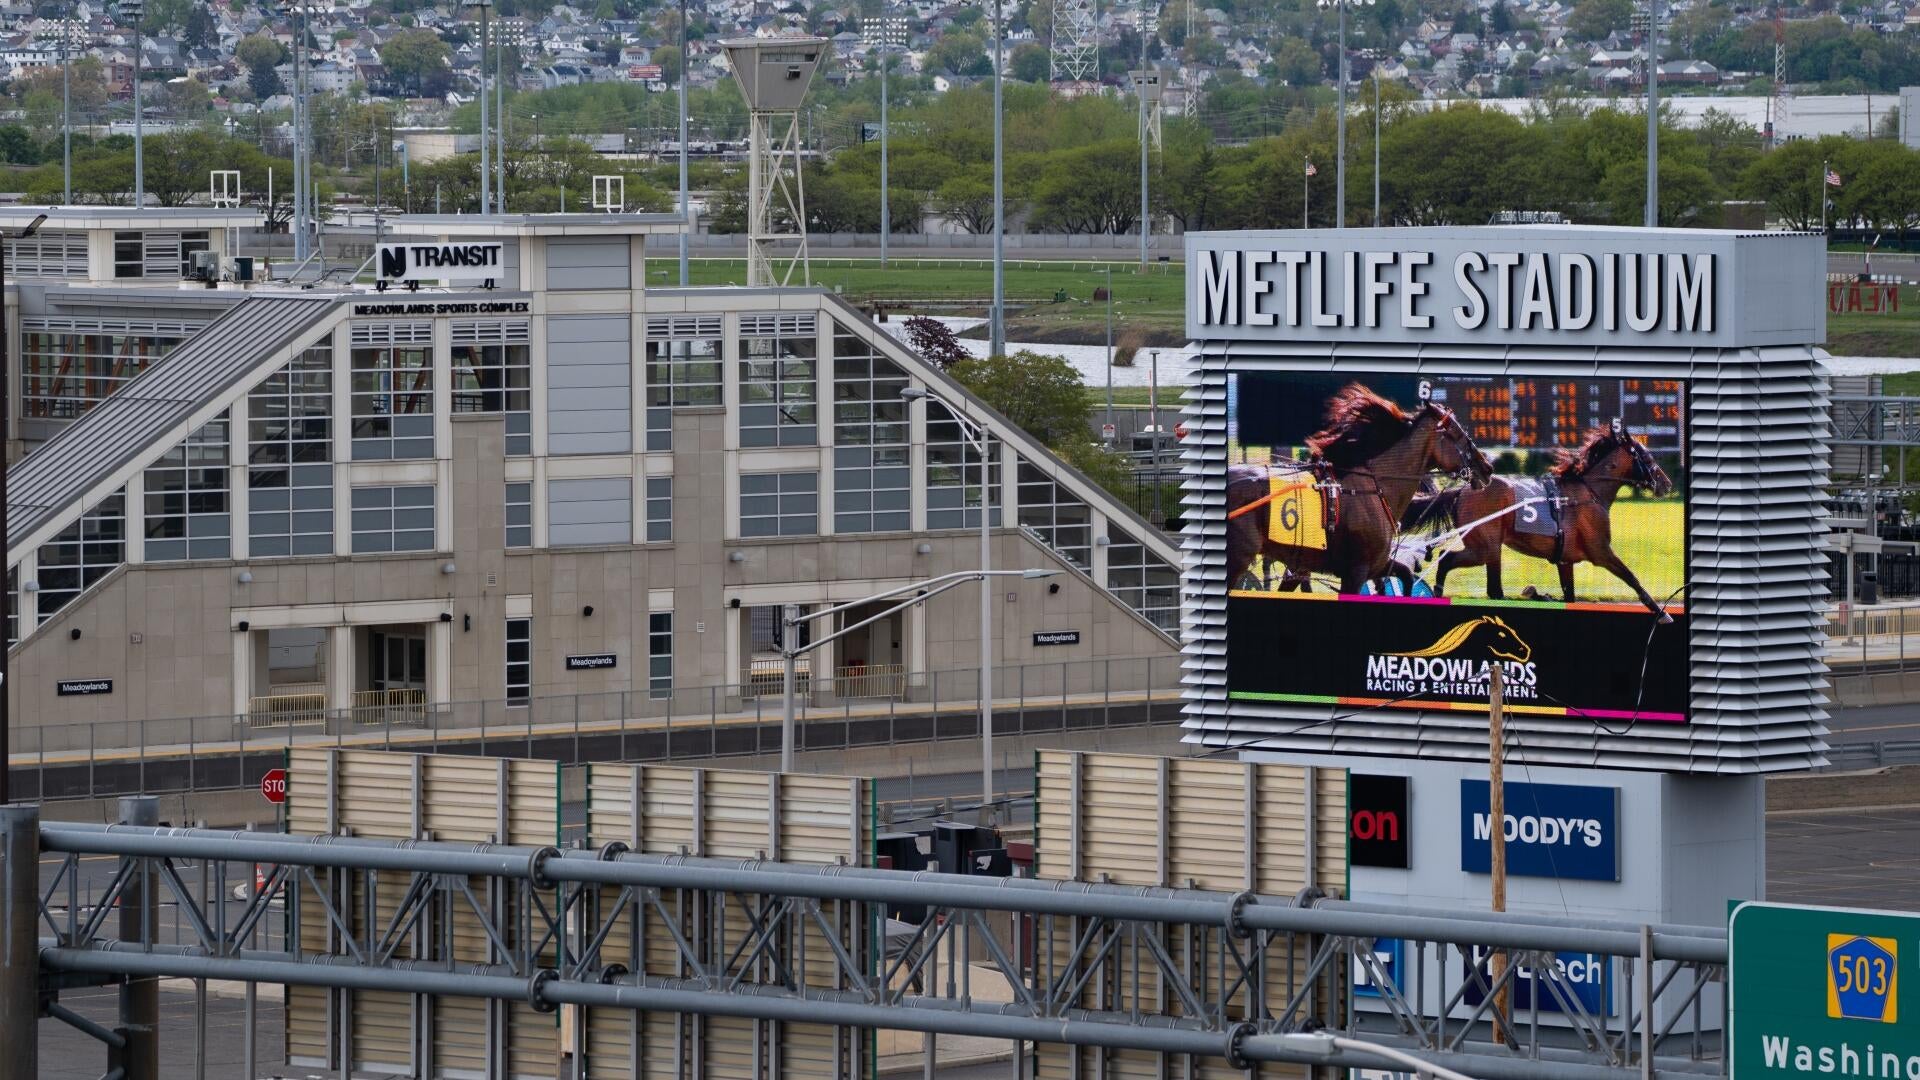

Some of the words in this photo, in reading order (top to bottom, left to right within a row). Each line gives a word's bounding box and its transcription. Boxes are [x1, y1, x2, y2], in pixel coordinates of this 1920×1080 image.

[382, 246, 407, 277] NJ
[411, 245, 501, 267] TRANSIT
[1197, 250, 1434, 328] METLIFE
[1454, 251, 1716, 333] STADIUM
[355, 303, 434, 315] MEADOWLANDS
[436, 303, 478, 313] SPORTS
[479, 302, 529, 313] COMPLEX
[1419, 380, 1431, 400] 6
[1612, 417, 1621, 433] 5
[1280, 498, 1300, 531] 6
[1521, 501, 1538, 523] 5
[1037, 633, 1076, 642] Meadowlands
[571, 656, 612, 665] Meadowlands
[62, 682, 108, 693] Meadowlands
[1367, 679, 1415, 692] RACING
[1420, 680, 1428, 692] &
[1432, 681, 1538, 698] ENTERTAIMENT
[264, 779, 285, 792] STO
[1350, 810, 1398, 841] on
[1473, 813, 1602, 847] MOODY'S
[1839, 955, 1887, 995] 503
